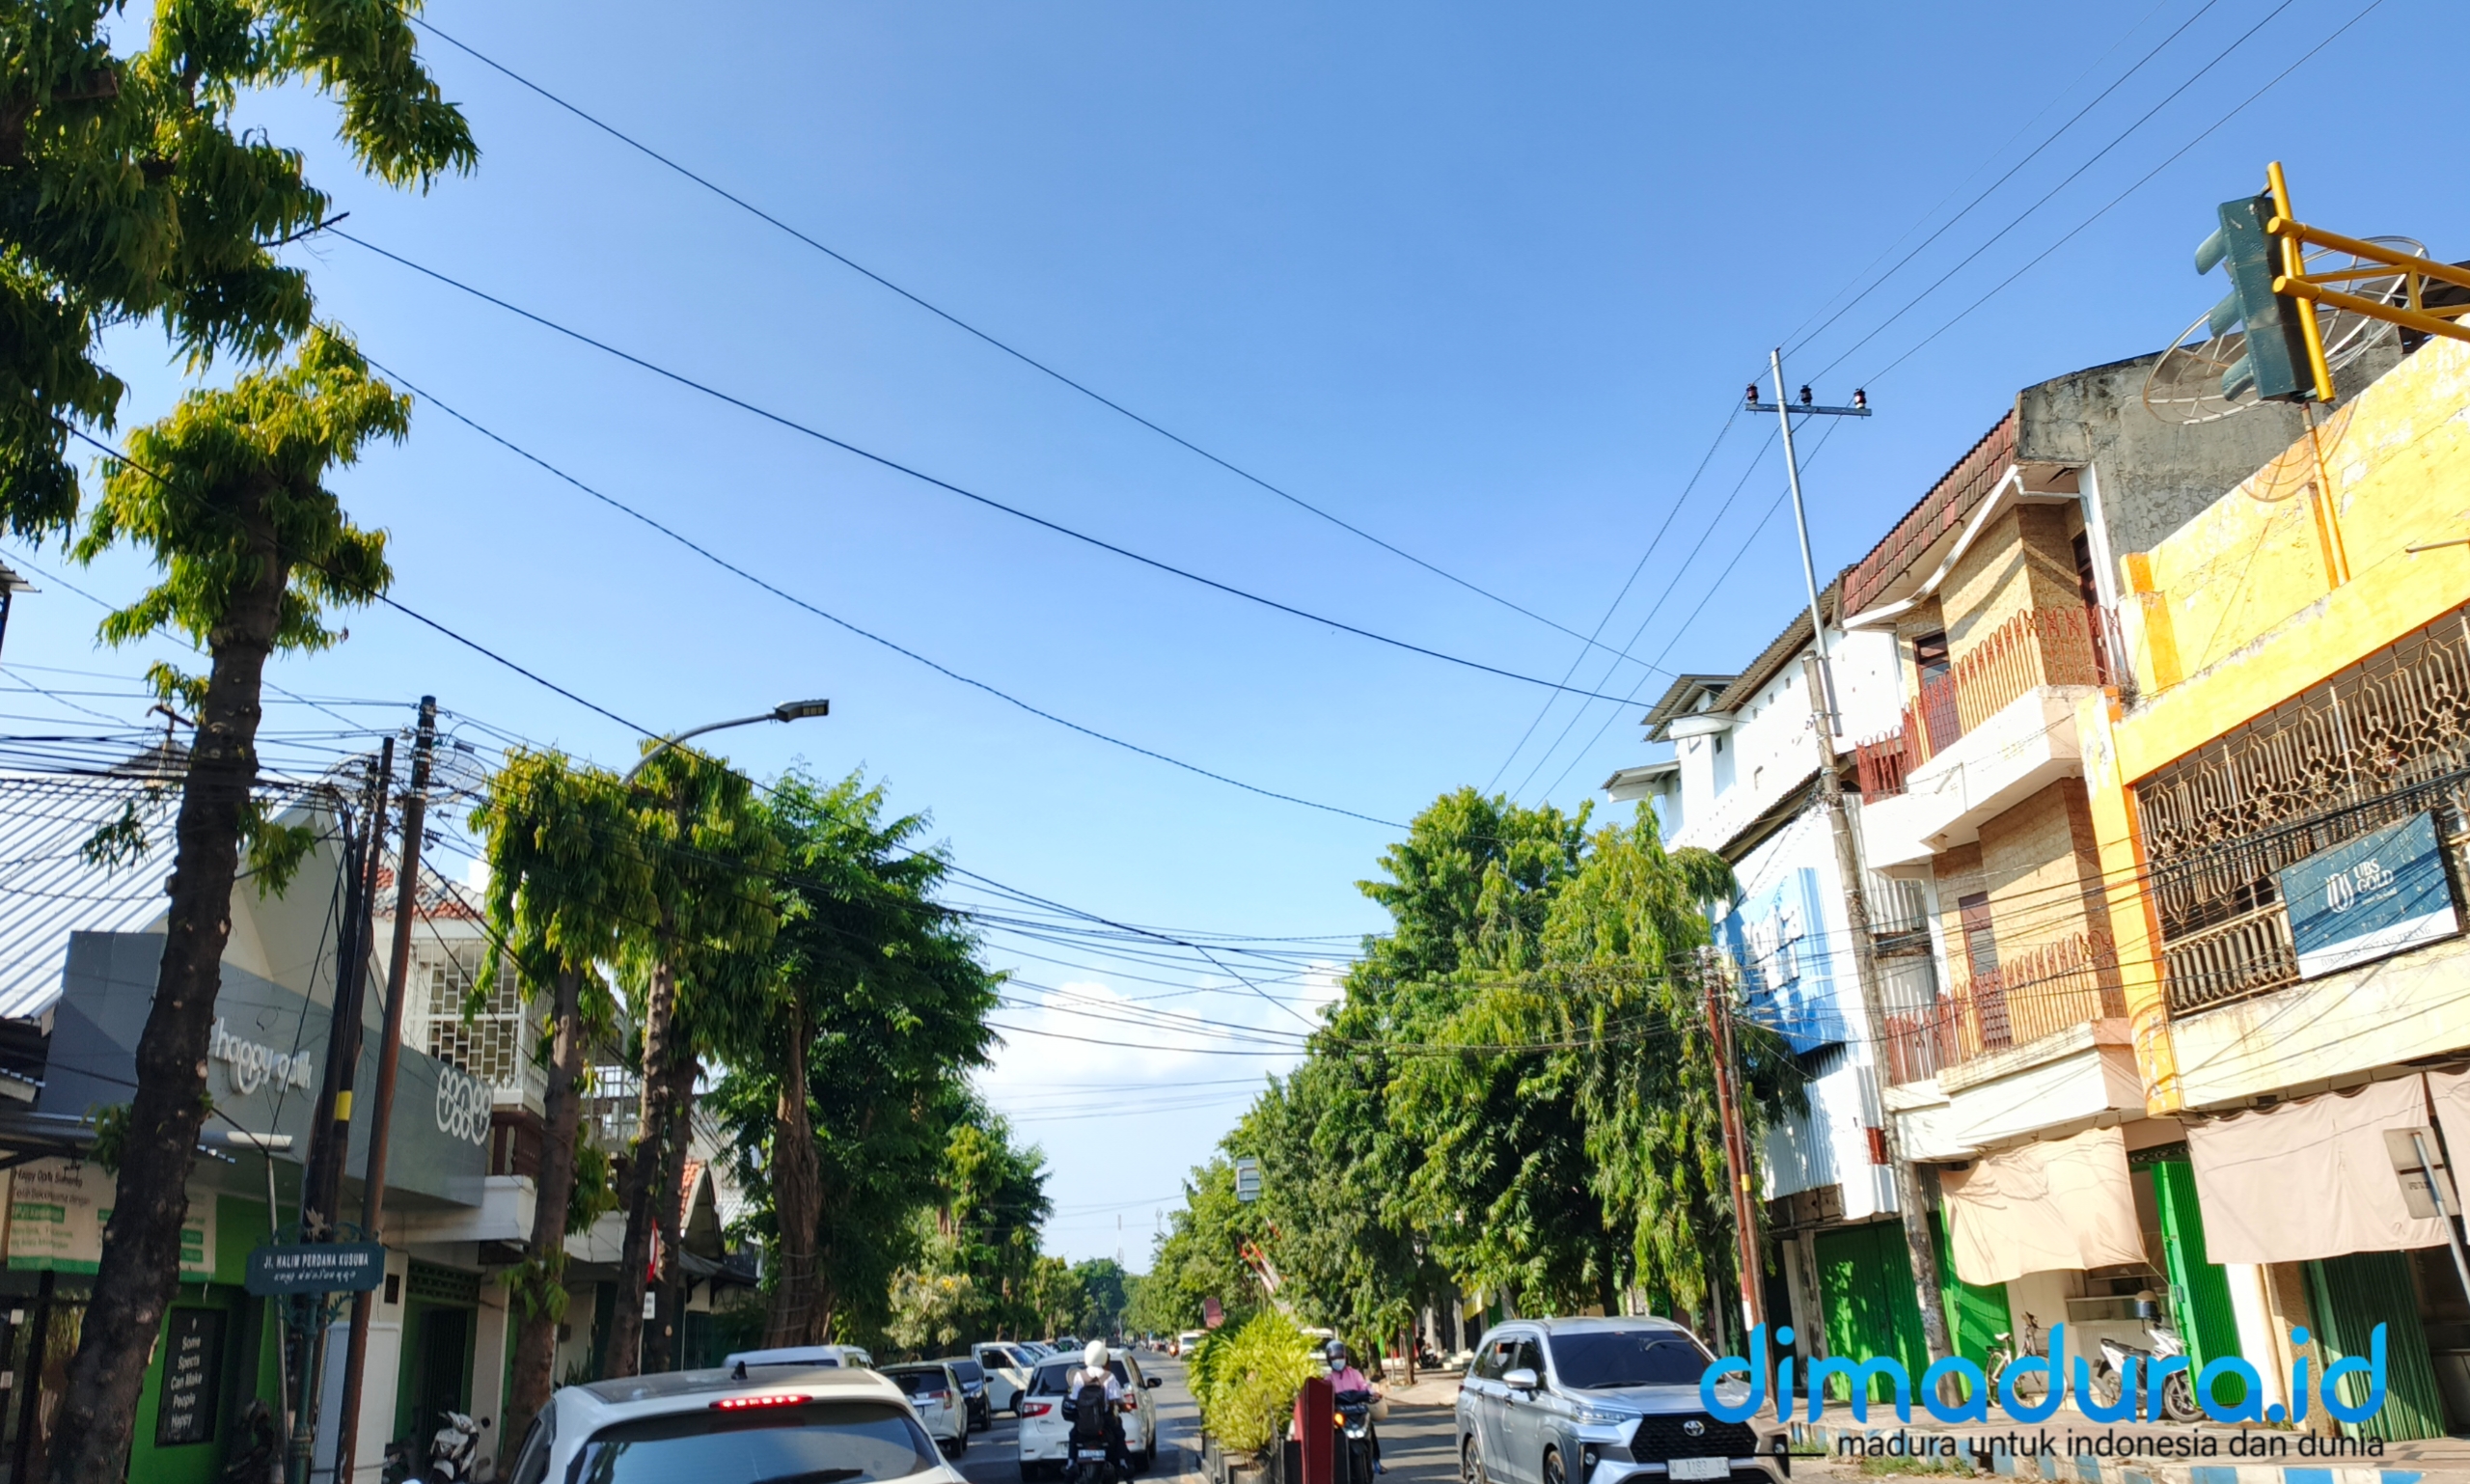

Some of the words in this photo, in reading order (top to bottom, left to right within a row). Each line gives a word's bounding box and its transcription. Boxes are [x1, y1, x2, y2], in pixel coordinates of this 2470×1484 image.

[2353, 859, 2380, 879] UBS
[2357, 869, 2394, 893] GOLD
[215, 1016, 273, 1094] happy
[276, 1254, 300, 1269] HALIM
[302, 1253, 337, 1268] PERDANA
[338, 1252, 369, 1267] KUSUMA
[171, 1375, 184, 1390] Can
[185, 1372, 203, 1388] Make
